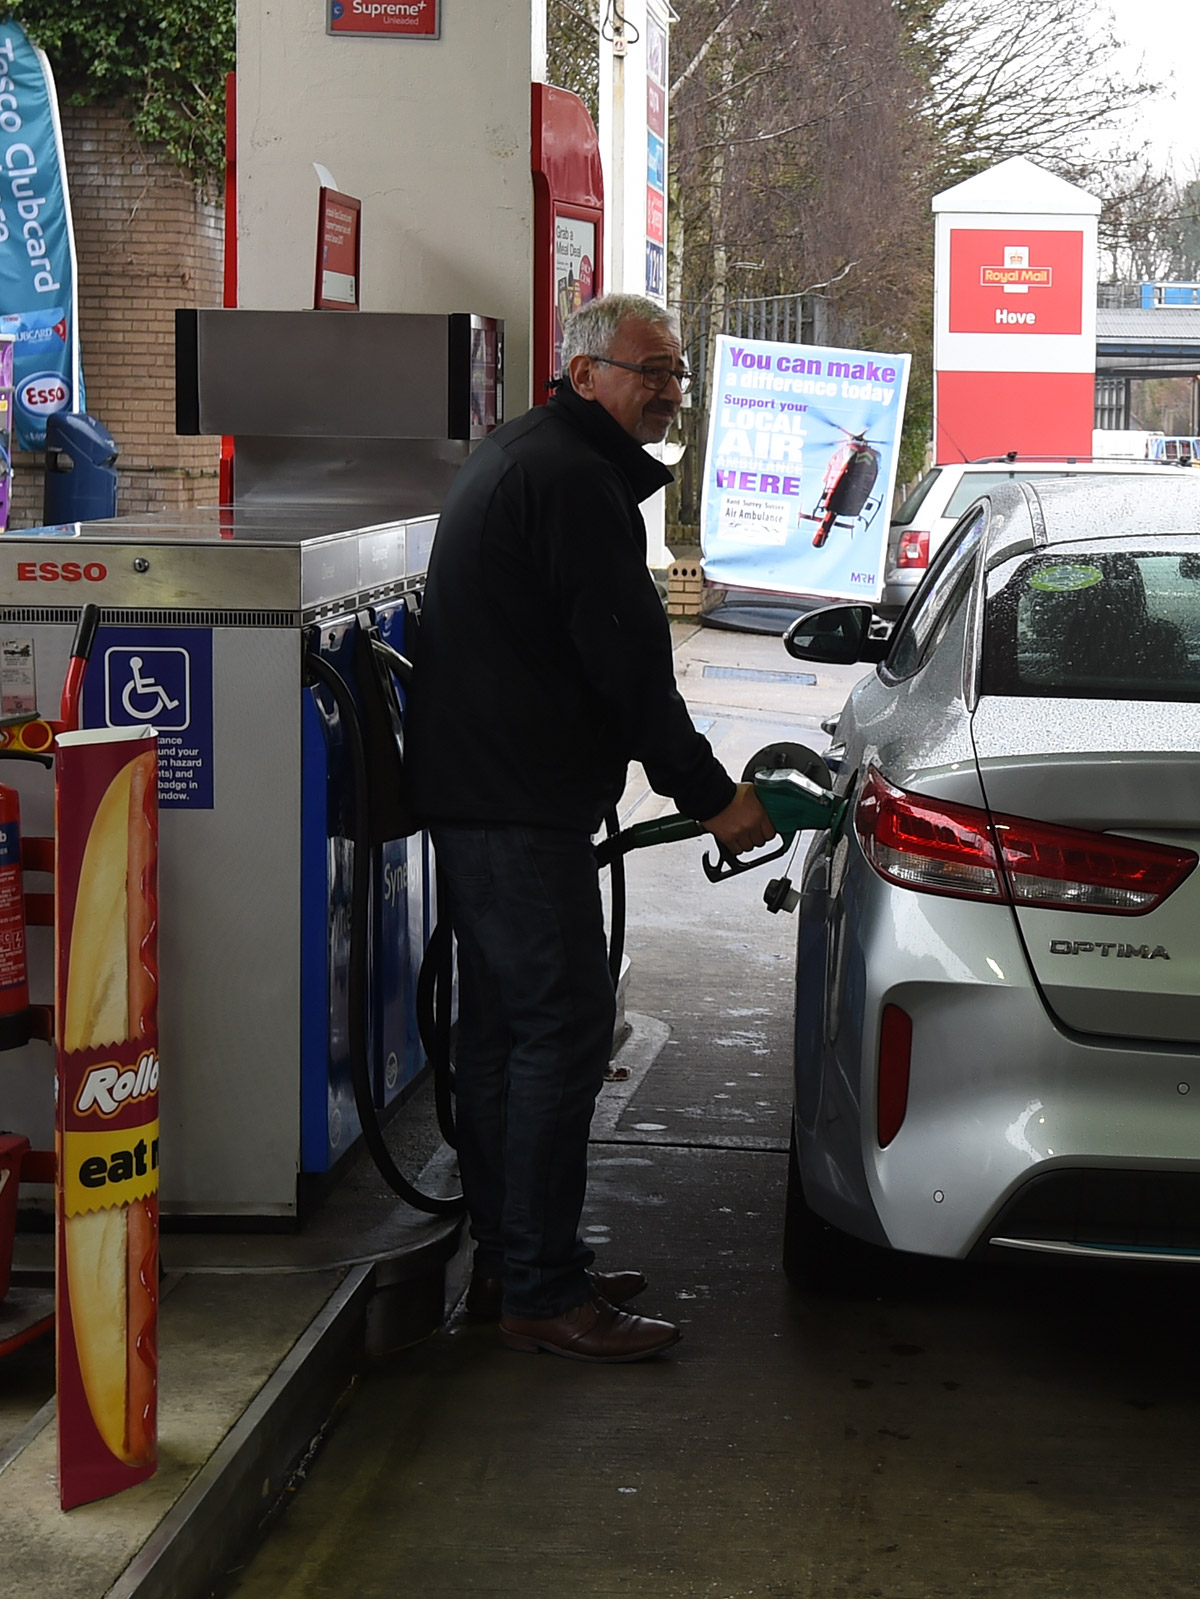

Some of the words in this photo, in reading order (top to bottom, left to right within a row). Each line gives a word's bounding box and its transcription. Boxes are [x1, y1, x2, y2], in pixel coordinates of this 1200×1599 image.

[382, 16, 419, 25] Unleaded
[5, 142, 61, 294] Clubcard
[556, 225, 569, 240] Grab
[570, 230, 574, 241] a
[556, 241, 569, 256] Meal
[570, 243, 582, 258] Deal
[985, 269, 1019, 283] Royal
[1020, 270, 1048, 282] Mail
[995, 308, 1036, 325] Hove
[16, 327, 53, 341] UBCARD
[729, 347, 772, 371] You
[776, 356, 822, 376] can
[827, 361, 897, 383] make
[725, 372, 737, 387] a
[740, 371, 838, 398] difference
[841, 381, 895, 406] today
[724, 393, 776, 409] Support
[779, 400, 809, 412] your
[720, 407, 808, 437] LOCAL
[716, 428, 805, 464] AIR
[715, 455, 804, 476] AMBULANCE
[716, 468, 801, 496] HERE
[742, 499, 762, 509] Surrey
[725, 507, 737, 518] Air
[738, 509, 783, 523] Ambulance
[17, 562, 108, 582] ESSO
[850, 572, 876, 585] MRH
[158, 747, 176, 756] und
[178, 748, 199, 757] your
[170, 758, 202, 767] hazard
[175, 769, 193, 778] and
[158, 780, 187, 791] badge
[189, 780, 198, 789] in
[158, 791, 190, 800] indow.
[1049, 939, 1171, 960] OPTIMA
[78, 1138, 148, 1188] eat
